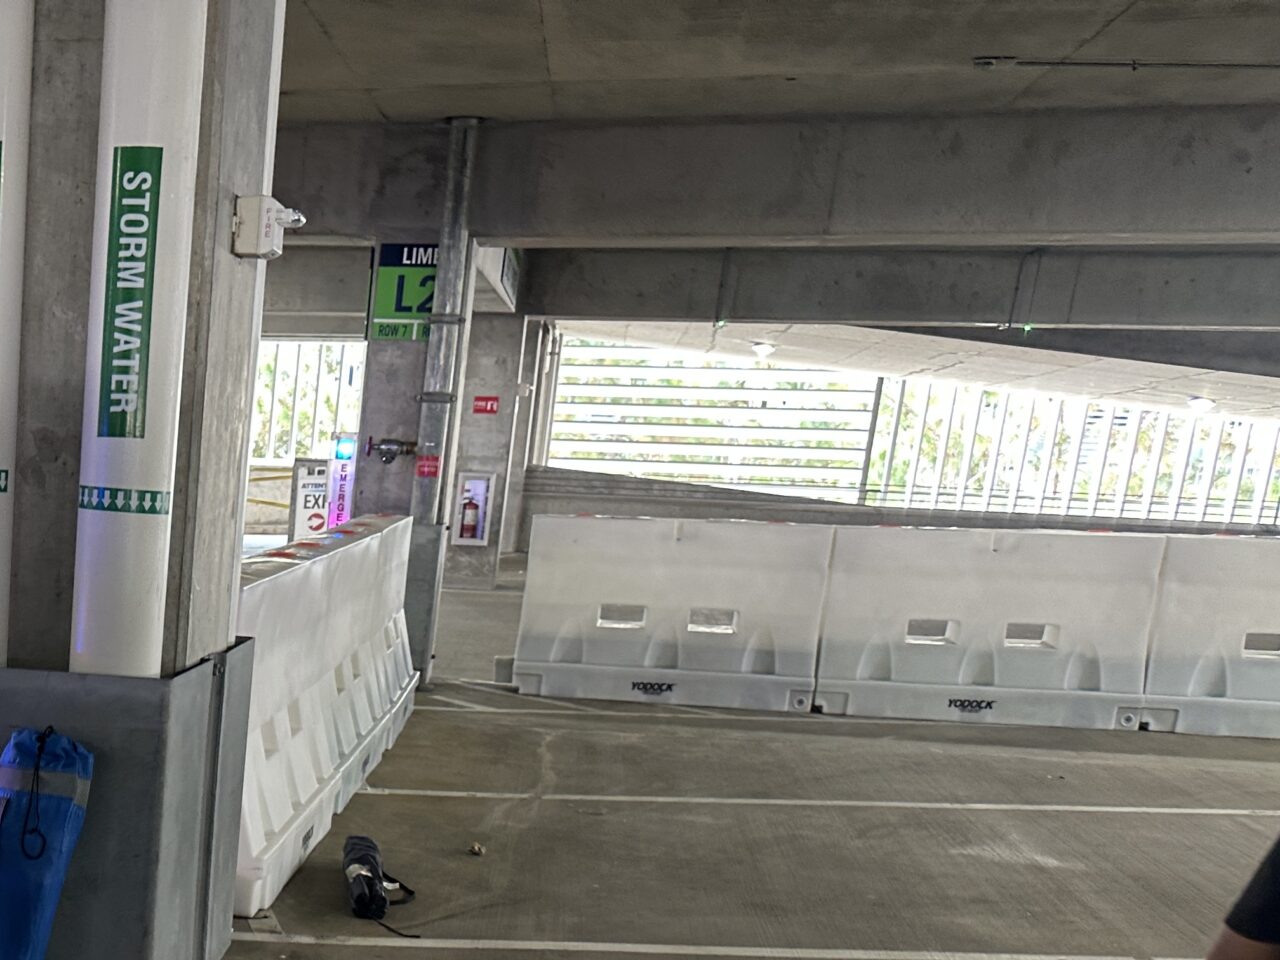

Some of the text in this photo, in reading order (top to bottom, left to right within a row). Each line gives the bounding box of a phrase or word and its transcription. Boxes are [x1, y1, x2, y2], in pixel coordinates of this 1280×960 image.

[264, 207, 272, 238] FIRE
[110, 171, 152, 413] STORM WATER
[378, 324, 399, 337] ROW
[401, 324, 408, 337] 7
[303, 494, 326, 509] EXI
[336, 463, 348, 525] EMERGE
[631, 681, 677, 692] YODOCK
[948, 698, 999, 710] YODOCK
